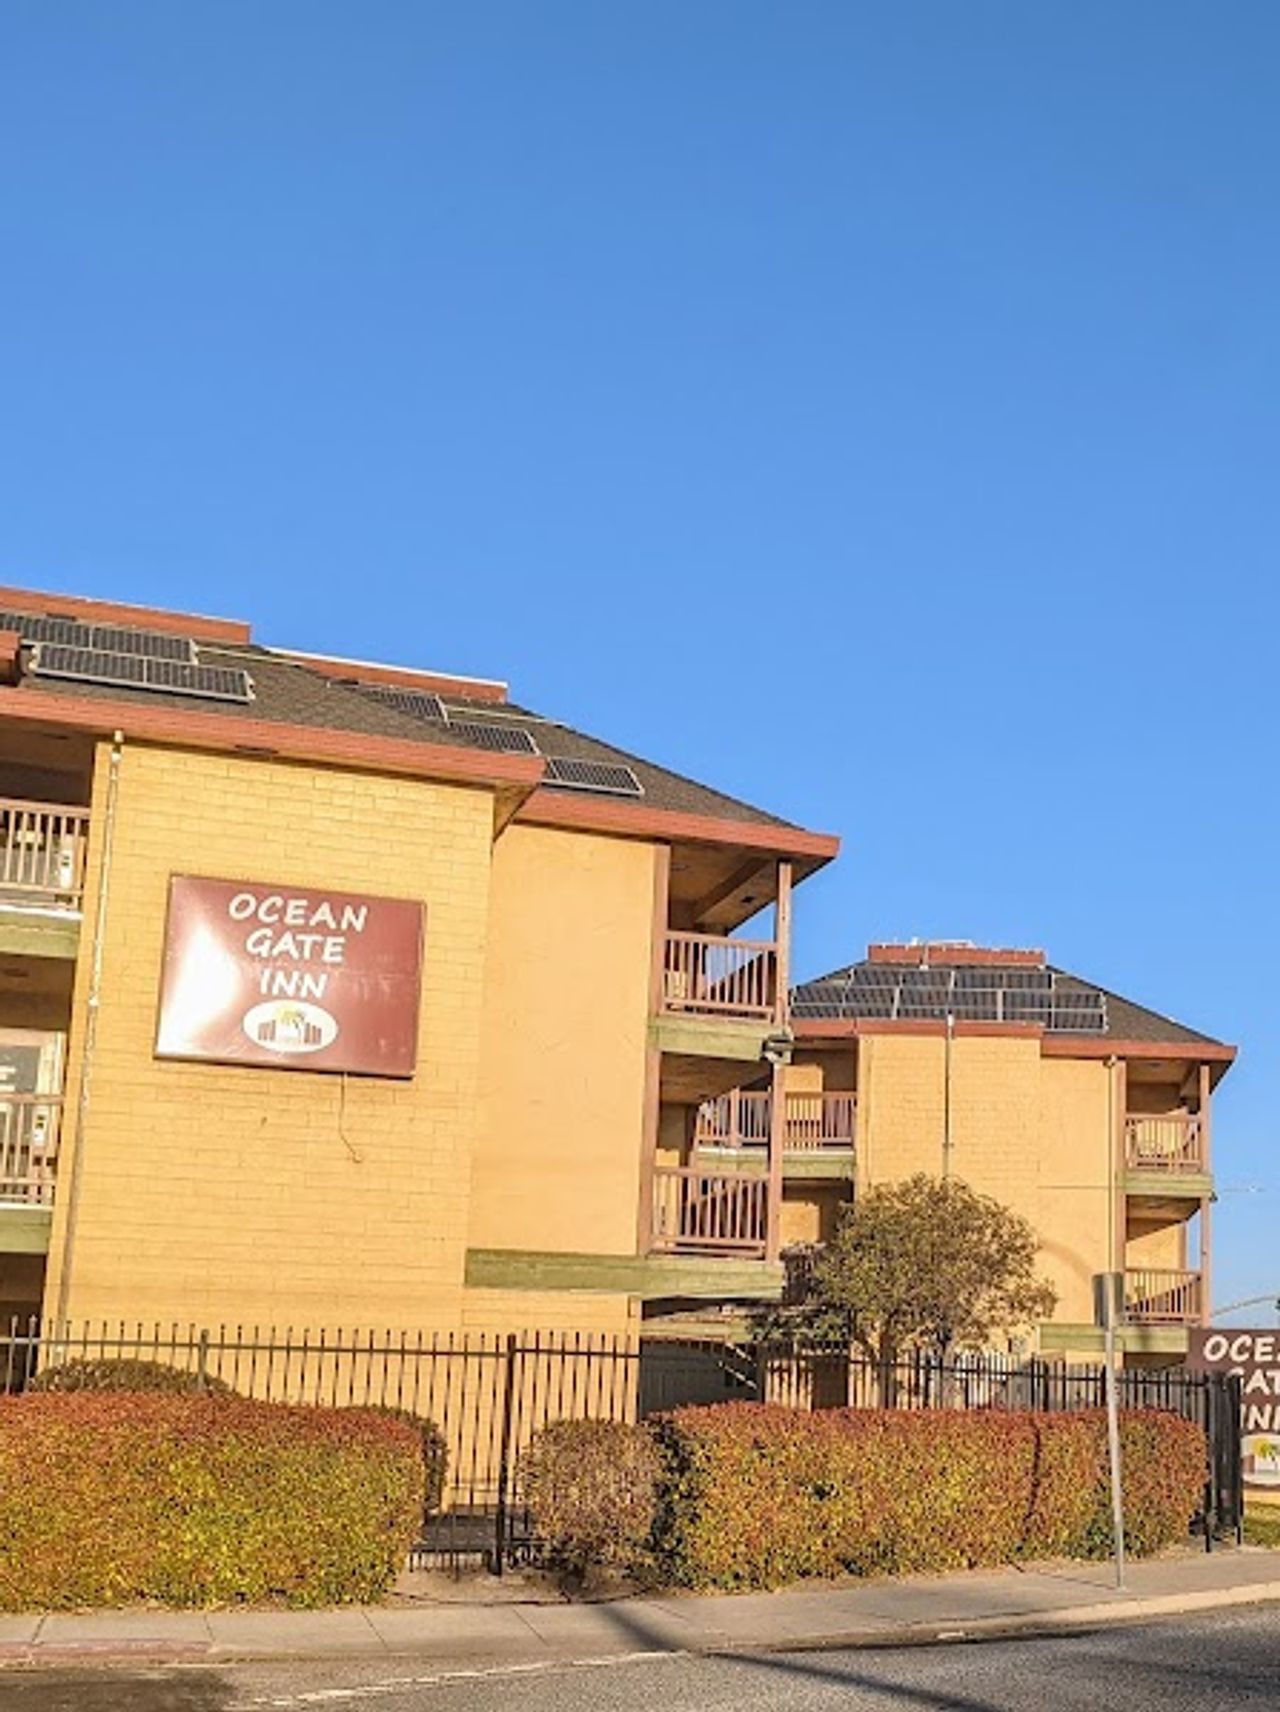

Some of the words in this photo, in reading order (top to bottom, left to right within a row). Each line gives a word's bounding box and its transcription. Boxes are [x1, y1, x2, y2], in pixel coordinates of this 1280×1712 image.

[228, 893, 368, 931] OCEAN
[245, 928, 346, 963] GATE
[259, 968, 328, 998] INN
[1203, 1334, 1280, 1362] OCE
